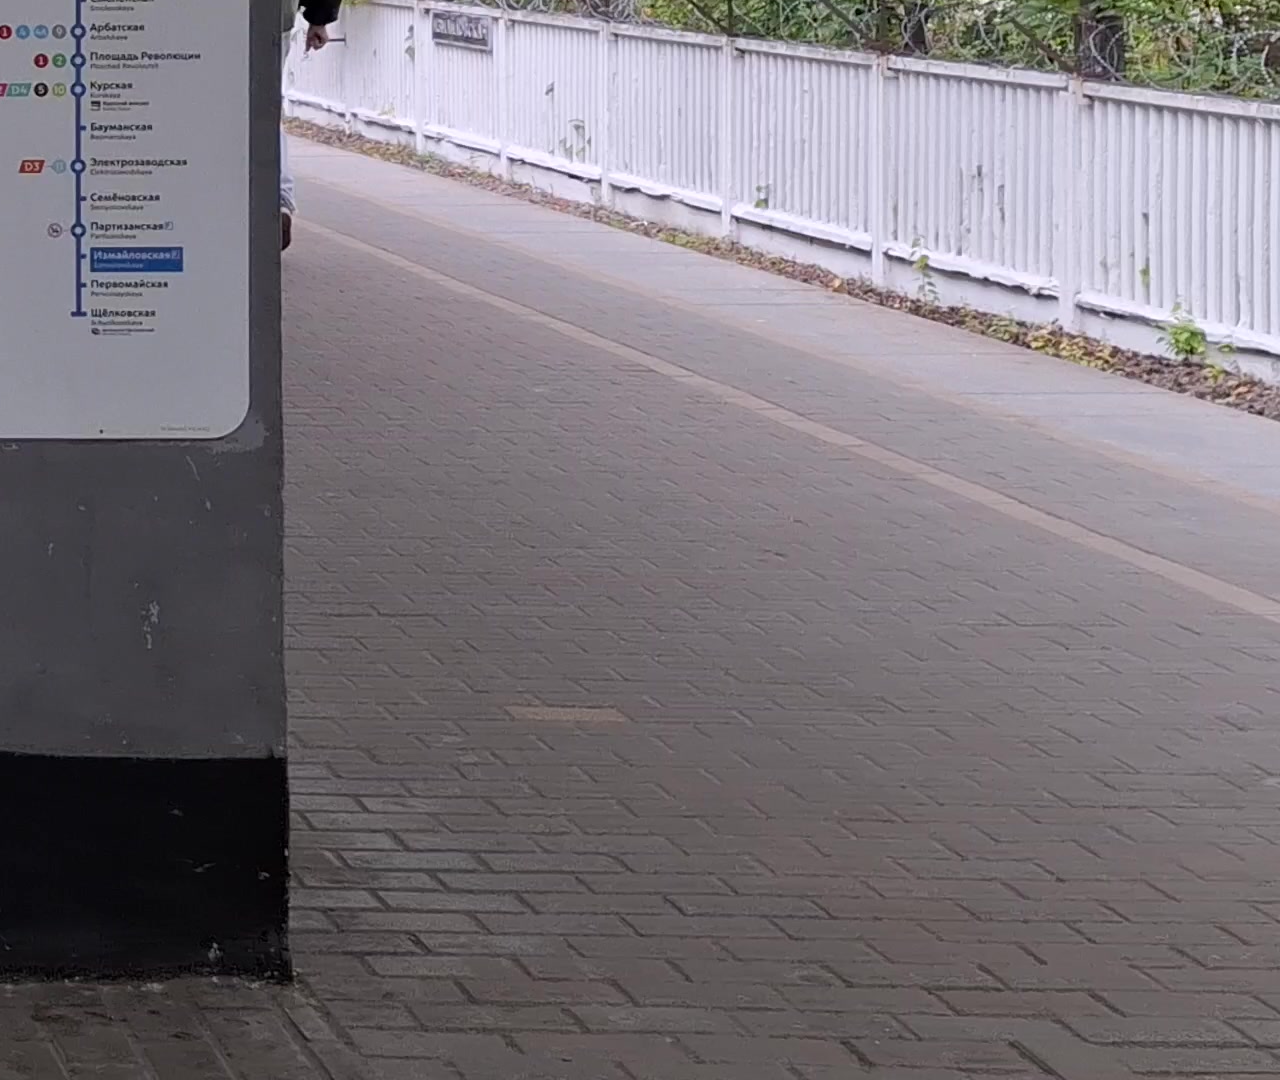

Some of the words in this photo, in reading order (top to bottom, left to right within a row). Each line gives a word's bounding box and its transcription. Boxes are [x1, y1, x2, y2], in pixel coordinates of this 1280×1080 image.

[90, 23, 144, 33] Арбатская
[90, 52, 138, 63] Площадь
[141, 52, 201, 62] Революции
[90, 82, 133, 92] Курская
[90, 123, 153, 133] Бауманская
[23, 162, 41, 172] D3
[90, 158, 188, 168] Электрозаводская
[90, 192, 160, 202] Семёновская
[90, 222, 164, 232] Партизанская
[93, 250, 171, 260] Измайловская
[91, 280, 169, 290] Первомайская
[91, 308, 156, 318] Щёлковская
